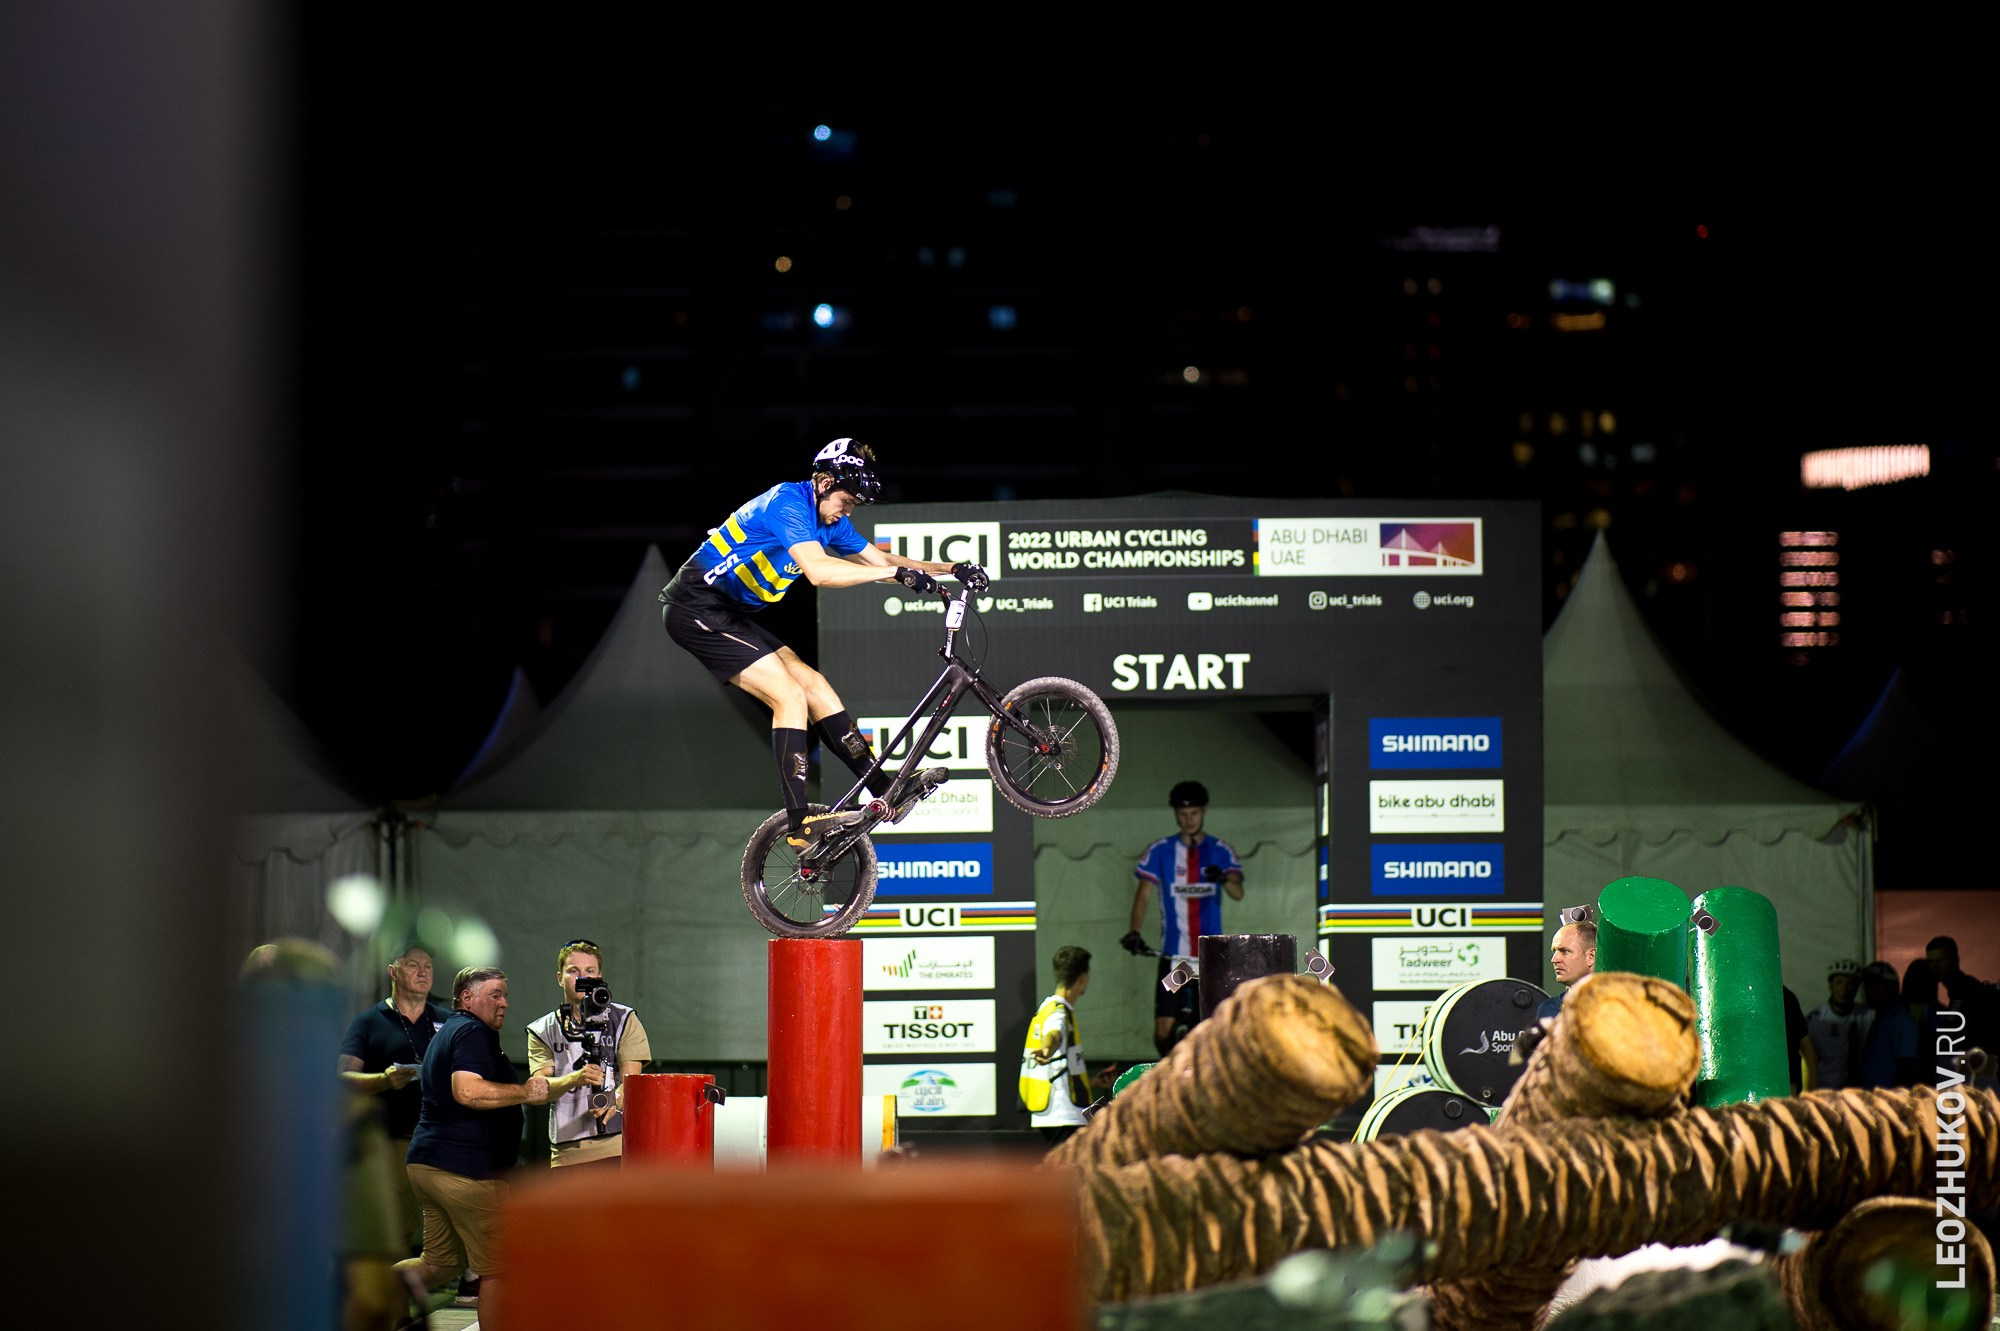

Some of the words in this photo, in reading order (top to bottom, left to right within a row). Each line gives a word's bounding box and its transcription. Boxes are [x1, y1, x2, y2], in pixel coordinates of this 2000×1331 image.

[1008, 531, 1052, 549] 2022
[1055, 530, 1121, 548] URBAN
[1124, 528, 1208, 548] CYCLING
[1270, 528, 1306, 544] ABU
[1312, 527, 1367, 544] DHABI
[898, 534, 988, 569] UCI
[1008, 551, 1080, 570] WORLD
[1083, 549, 1245, 569] CHAMPIONSHIPS
[1271, 550, 1306, 566] UAE
[996, 598, 1054, 612] UCI_Trials
[1103, 596, 1125, 609] UCI
[1127, 595, 1158, 609] Trials
[1214, 593, 1279, 608] ucichannel
[1329, 593, 1383, 609] uci_trials
[1433, 594, 1475, 609] uci.org
[1111, 652, 1251, 692] START
[880, 726, 968, 761] UCI
[1382, 734, 1490, 753] SHIMANO
[1378, 794, 1410, 808] bike
[1414, 794, 1445, 808] abu
[1449, 793, 1495, 808] dhabi
[877, 860, 981, 879] SHIMANO
[1383, 861, 1492, 879] SHIMANO
[905, 907, 955, 927] UCI
[1416, 907, 1467, 928] UCI
[1399, 957, 1453, 968] Tadweer
[882, 1022, 975, 1039] TISSOT
[1491, 1030, 1516, 1042] Abu
